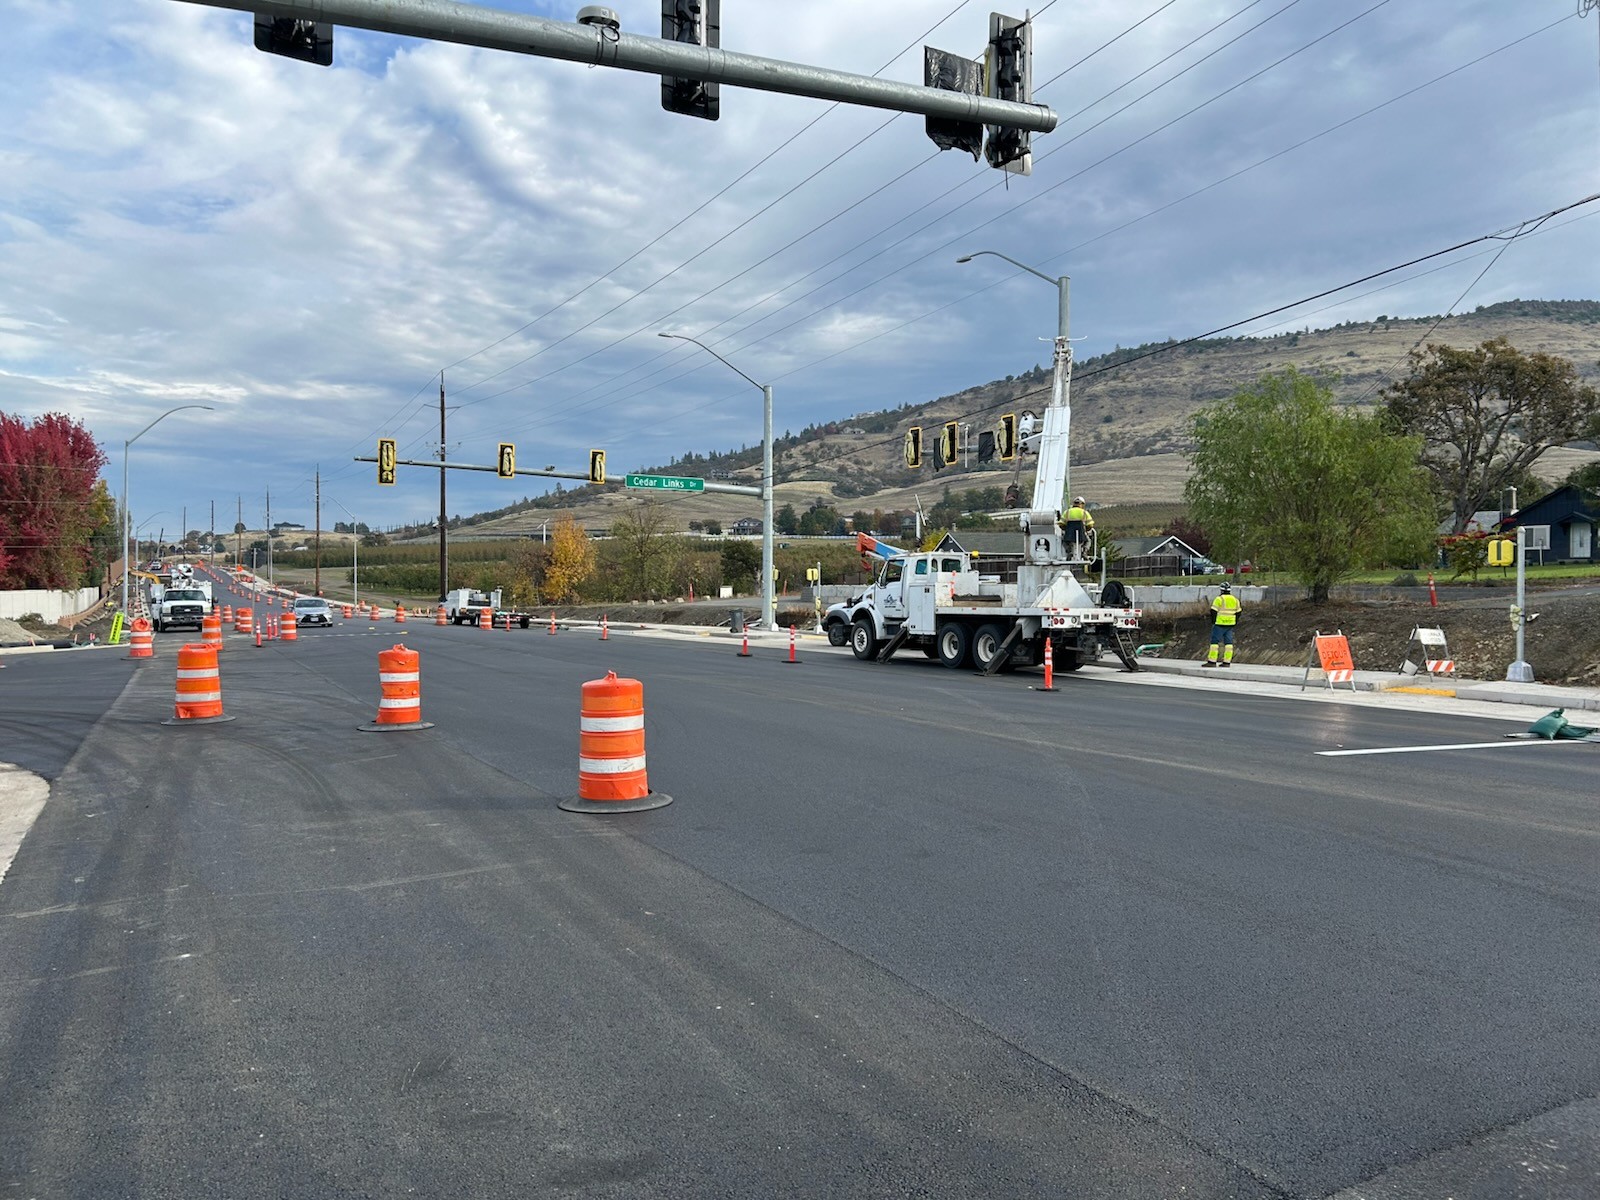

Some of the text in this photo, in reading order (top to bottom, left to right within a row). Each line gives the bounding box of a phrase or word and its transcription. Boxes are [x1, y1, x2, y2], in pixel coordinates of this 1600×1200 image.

[634, 477, 657, 486] Cedar
[663, 479, 684, 488] Links
[1322, 650, 1348, 660] DETOUR
